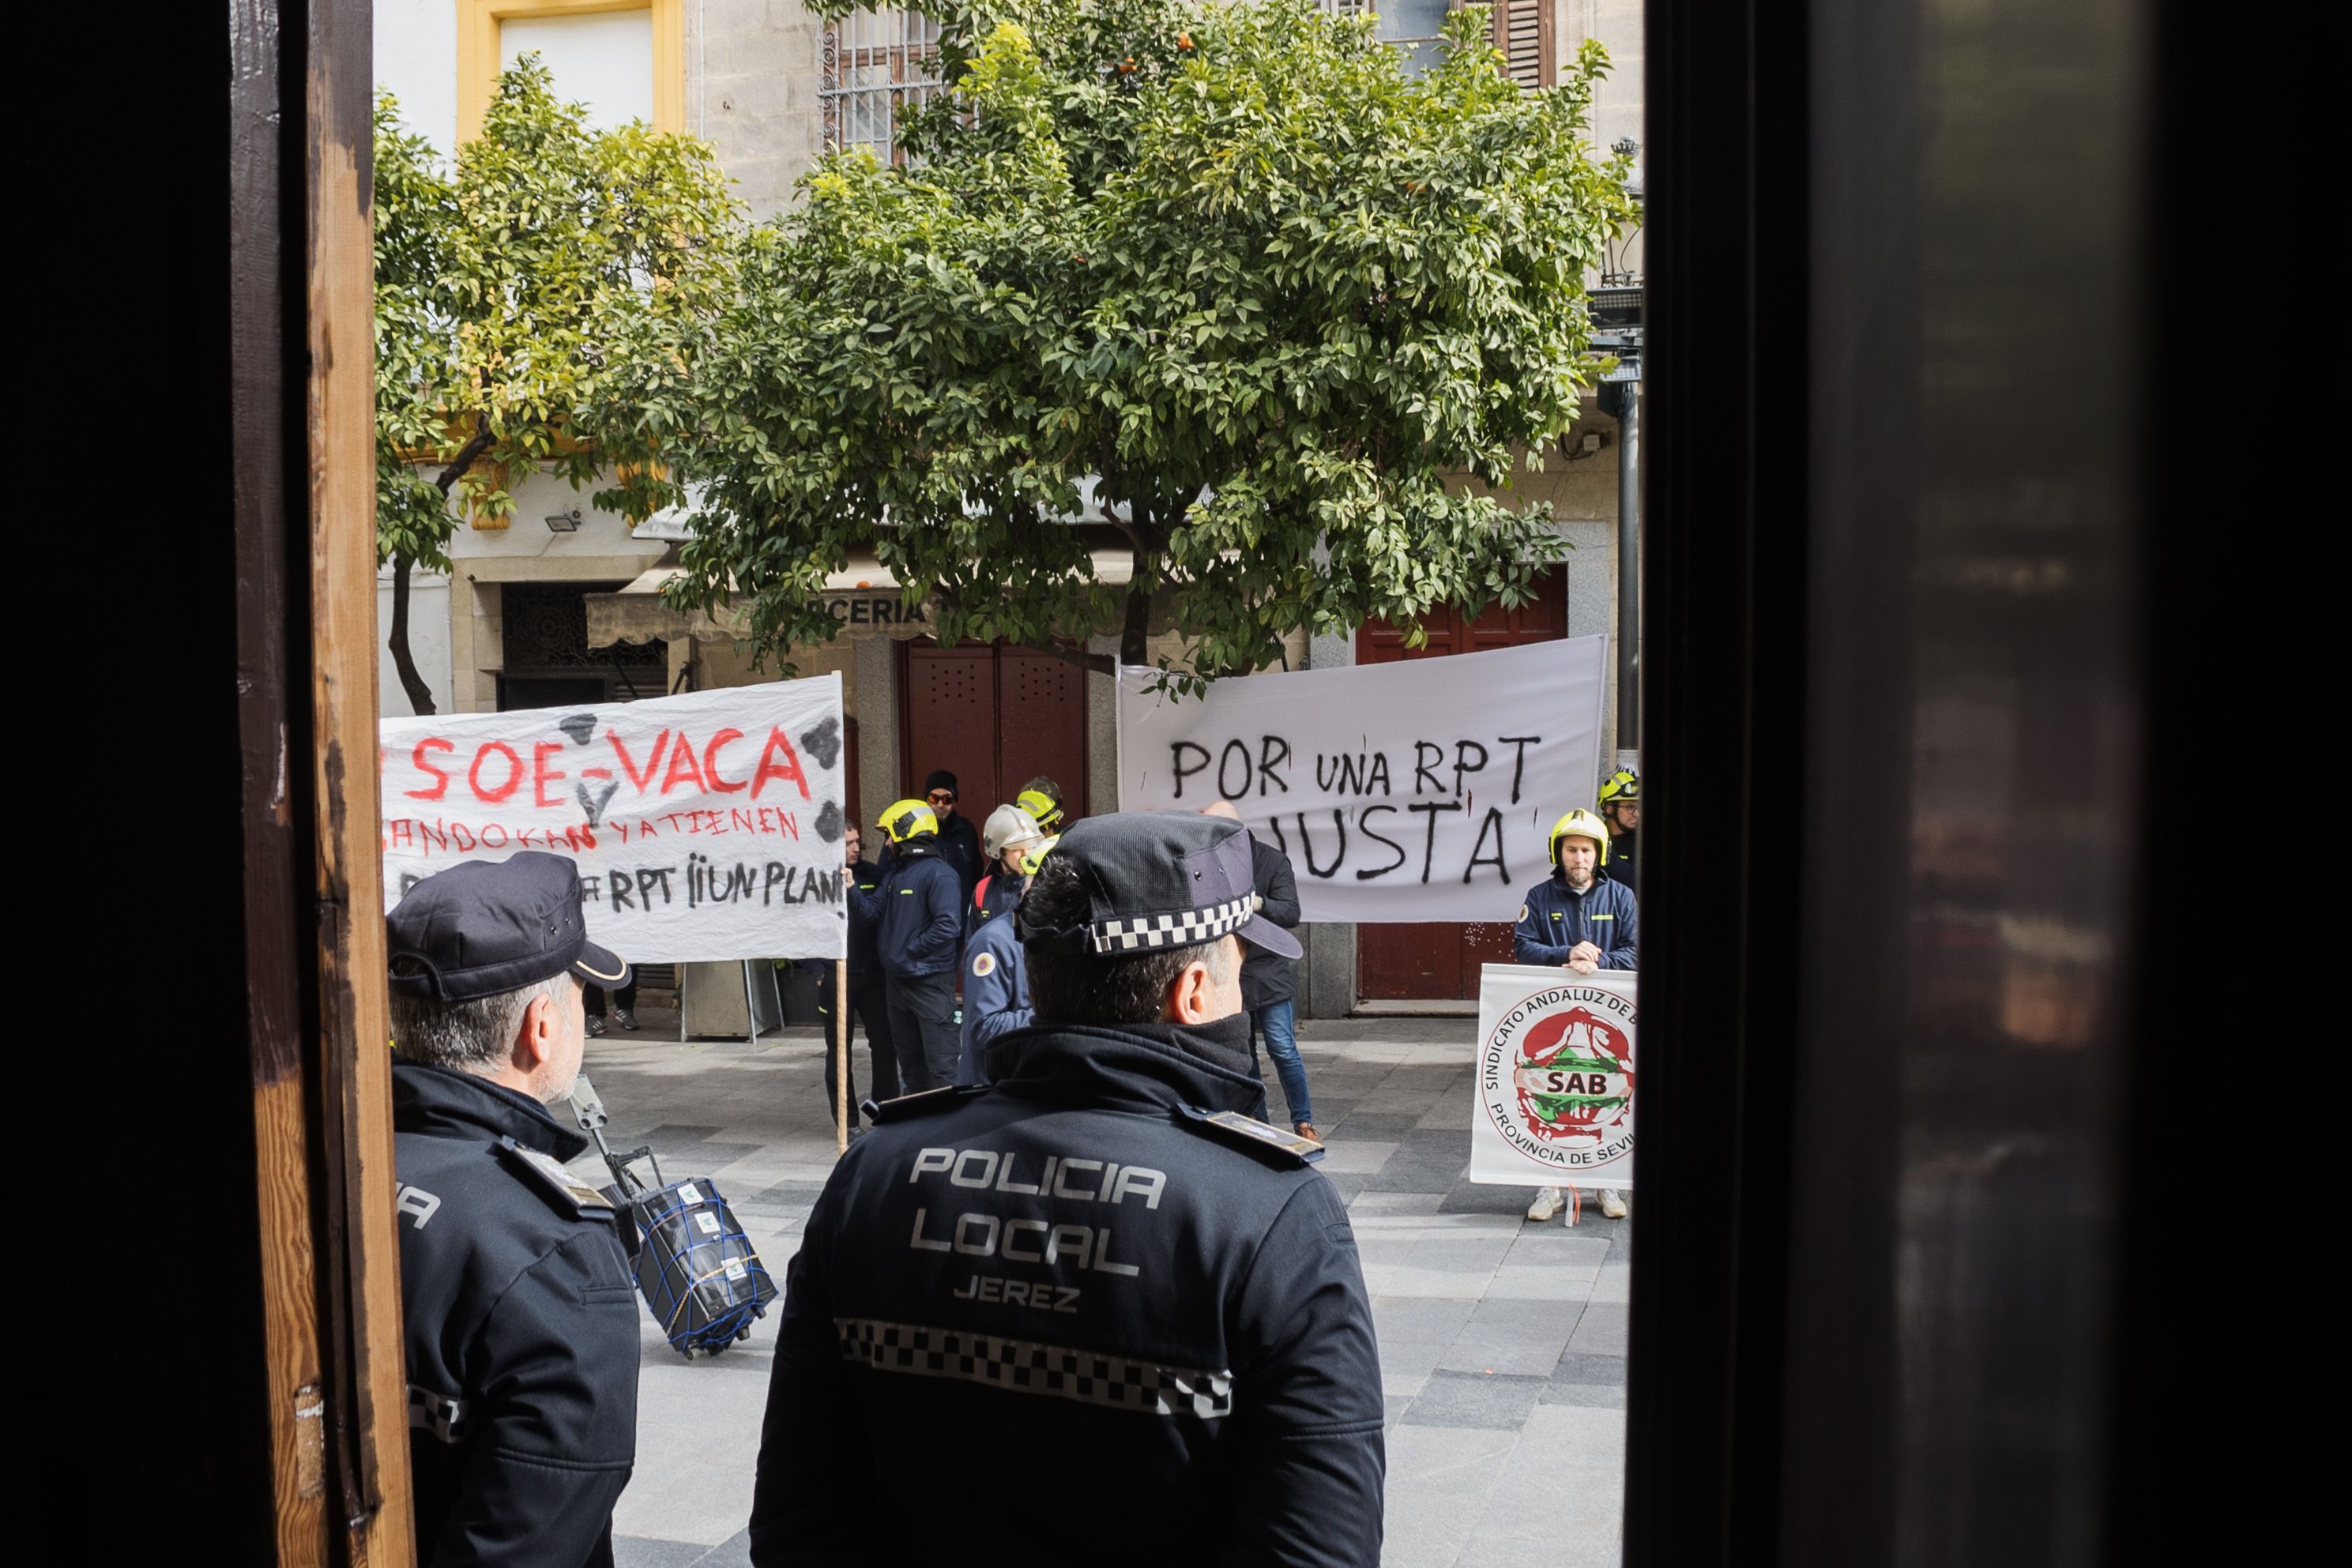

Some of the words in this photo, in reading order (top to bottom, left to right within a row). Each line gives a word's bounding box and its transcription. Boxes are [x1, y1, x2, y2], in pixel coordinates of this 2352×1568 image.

[381, 724, 812, 808] SOE-VACA
[1169, 735, 1288, 801] POR
[1316, 751, 1391, 795] UNA
[1414, 736, 1542, 805] RPT
[609, 867, 676, 913] RPT
[1485, 1010, 1526, 1090] SINDICATO
[1526, 987, 1606, 1014] ANDALUZ
[1607, 997, 1630, 1017] DE
[1546, 1071, 1608, 1095] SAB
[1491, 1104, 1565, 1164] PROVINCIA
[1570, 1152, 1593, 1164] DE
[909, 1147, 1168, 1210] POLICIA
[909, 1208, 1140, 1277] LOCAL
[953, 1275, 1082, 1314] JEREZ
